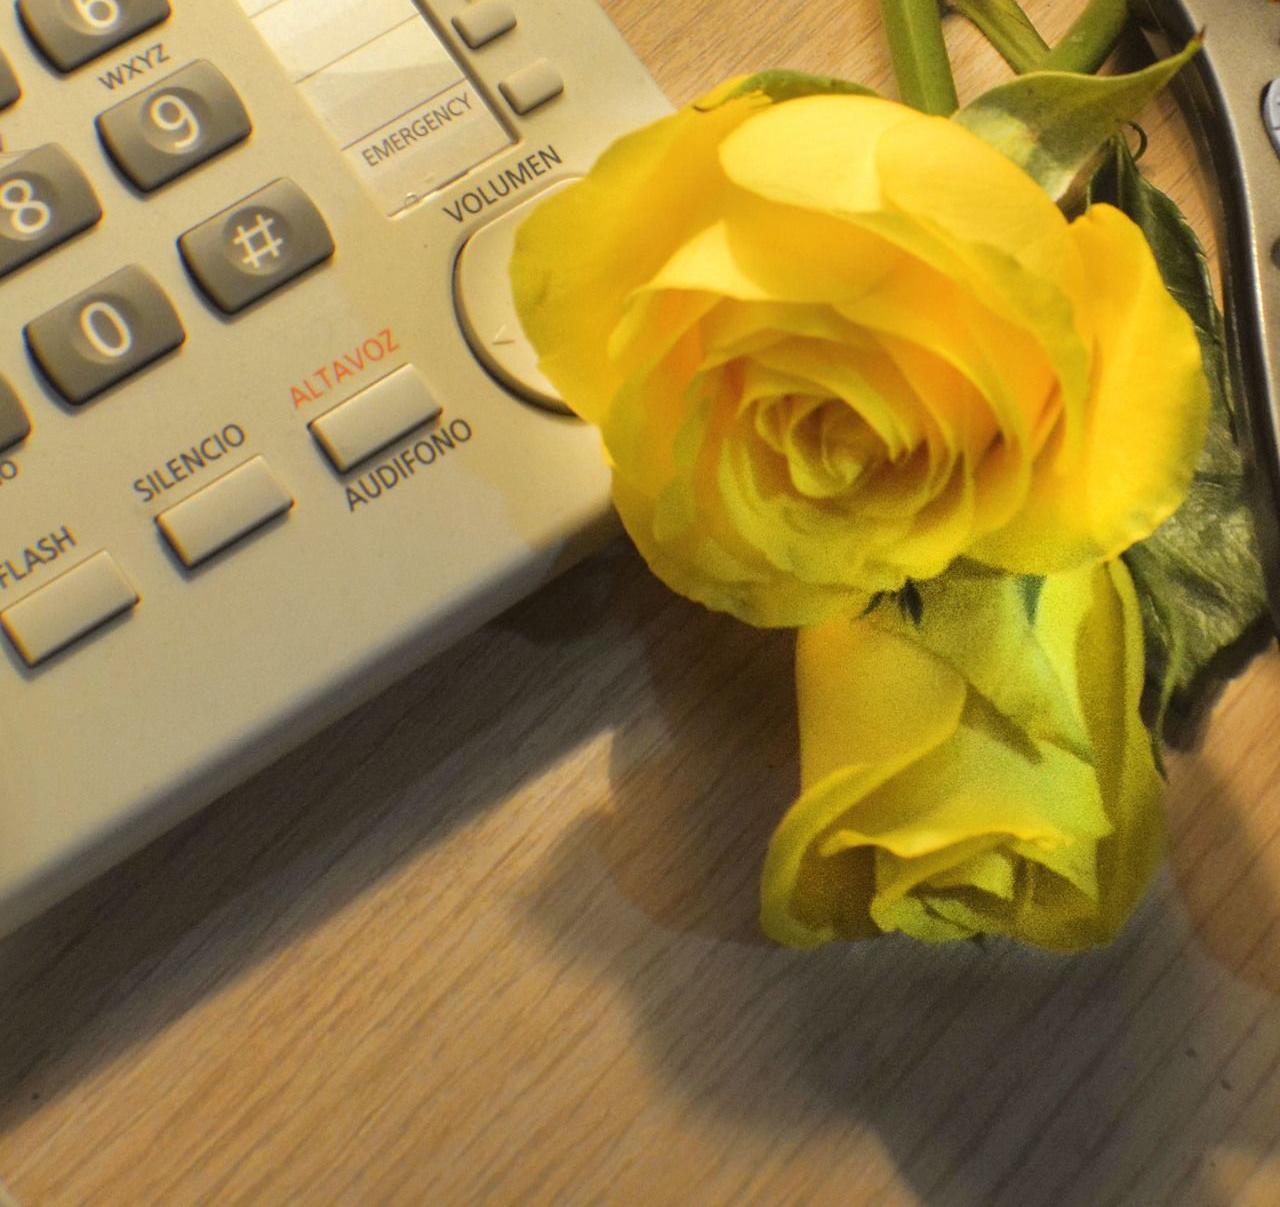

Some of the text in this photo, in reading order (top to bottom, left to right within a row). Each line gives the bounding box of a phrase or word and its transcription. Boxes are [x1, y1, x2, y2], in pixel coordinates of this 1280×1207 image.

[97, 43, 172, 93] WXYZ
[150, 94, 201, 148] 9
[361, 91, 475, 168] EMERGENCY
[442, 144, 563, 224] VOLUMEN
[231, 212, 285, 269] #
[80, 300, 132, 358] 0
[289, 328, 401, 410] ALTAVOZ
[132, 423, 247, 504] SILENCIO
[344, 417, 474, 513] AUDIFONO
